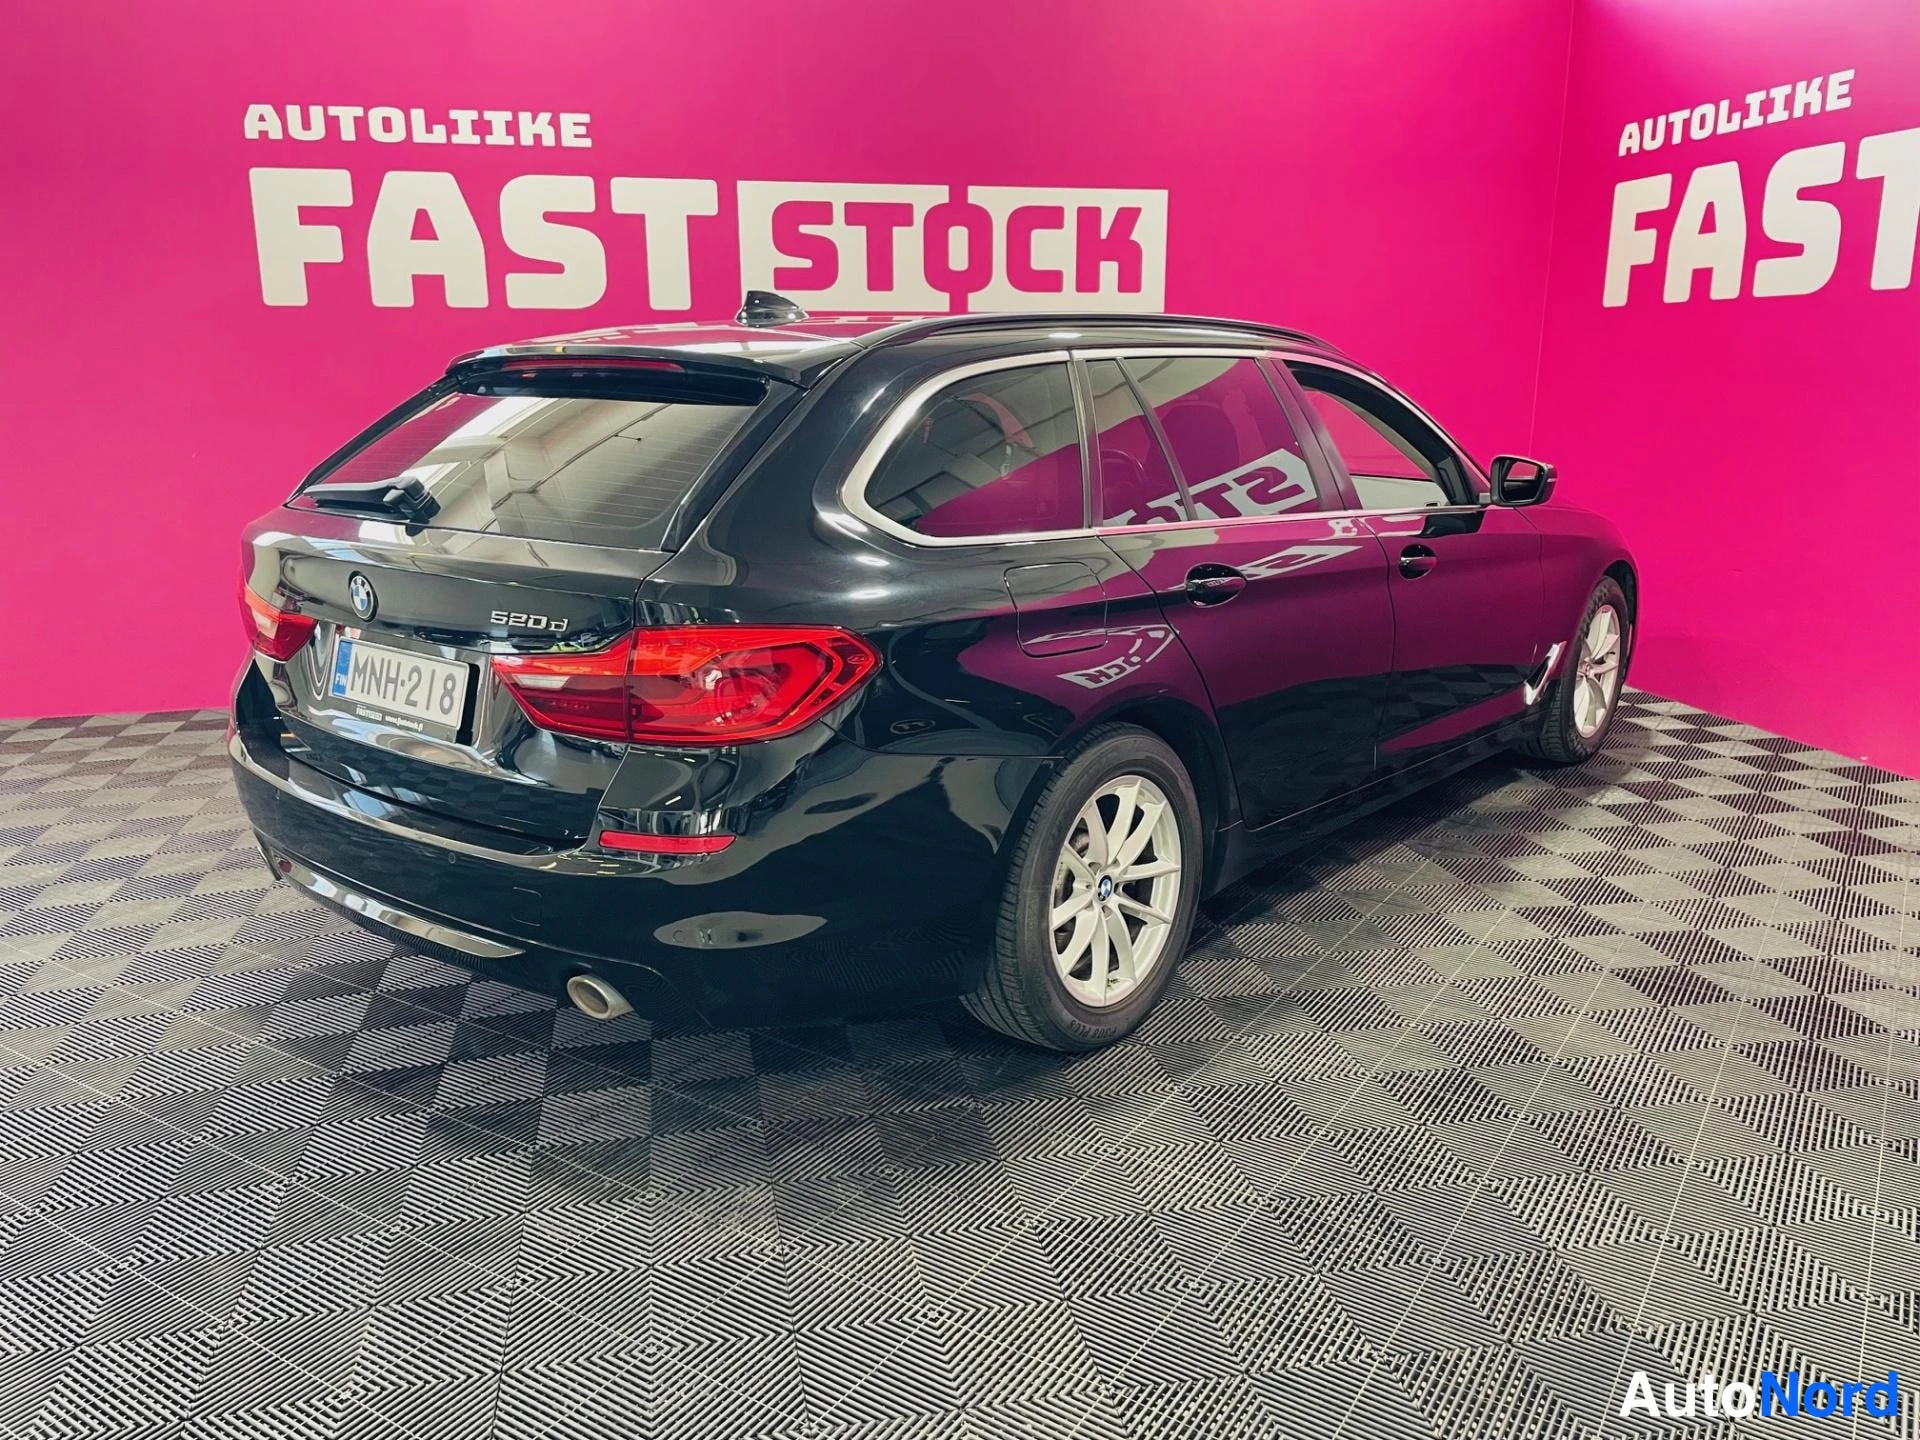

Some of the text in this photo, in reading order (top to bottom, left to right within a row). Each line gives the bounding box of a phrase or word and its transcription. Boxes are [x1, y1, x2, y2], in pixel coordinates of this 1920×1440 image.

[243, 103, 593, 148] AUTOLIIKE
[1618, 68, 1855, 157] AUTOLIIKE
[248, 166, 1144, 311] FAST STOCK
[334, 672, 348, 686] FIN
[350, 651, 457, 716] MNH-218
